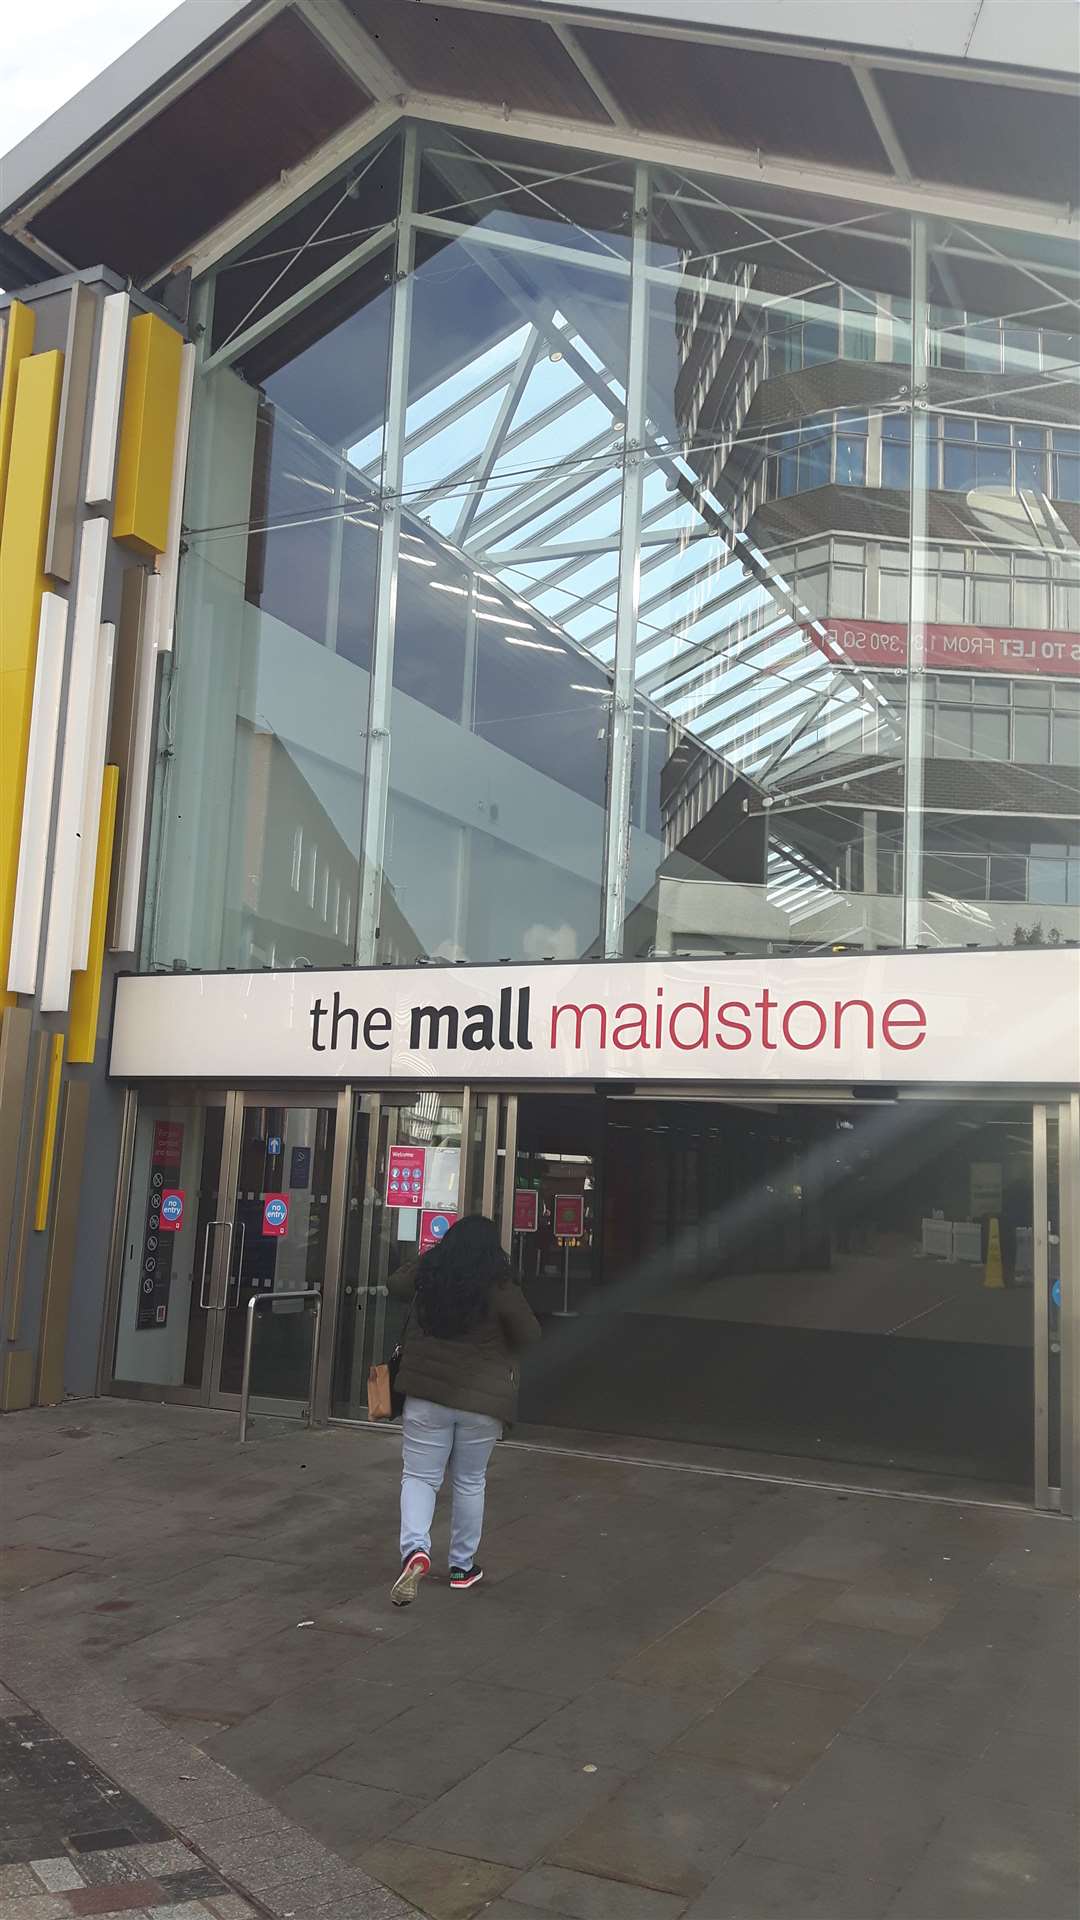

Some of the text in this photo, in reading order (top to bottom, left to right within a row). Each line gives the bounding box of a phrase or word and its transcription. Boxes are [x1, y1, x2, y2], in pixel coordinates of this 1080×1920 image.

[310, 986, 927, 1051] the mall maidstone
[163, 1206, 181, 1215] entry
[267, 1211, 285, 1220] entry
